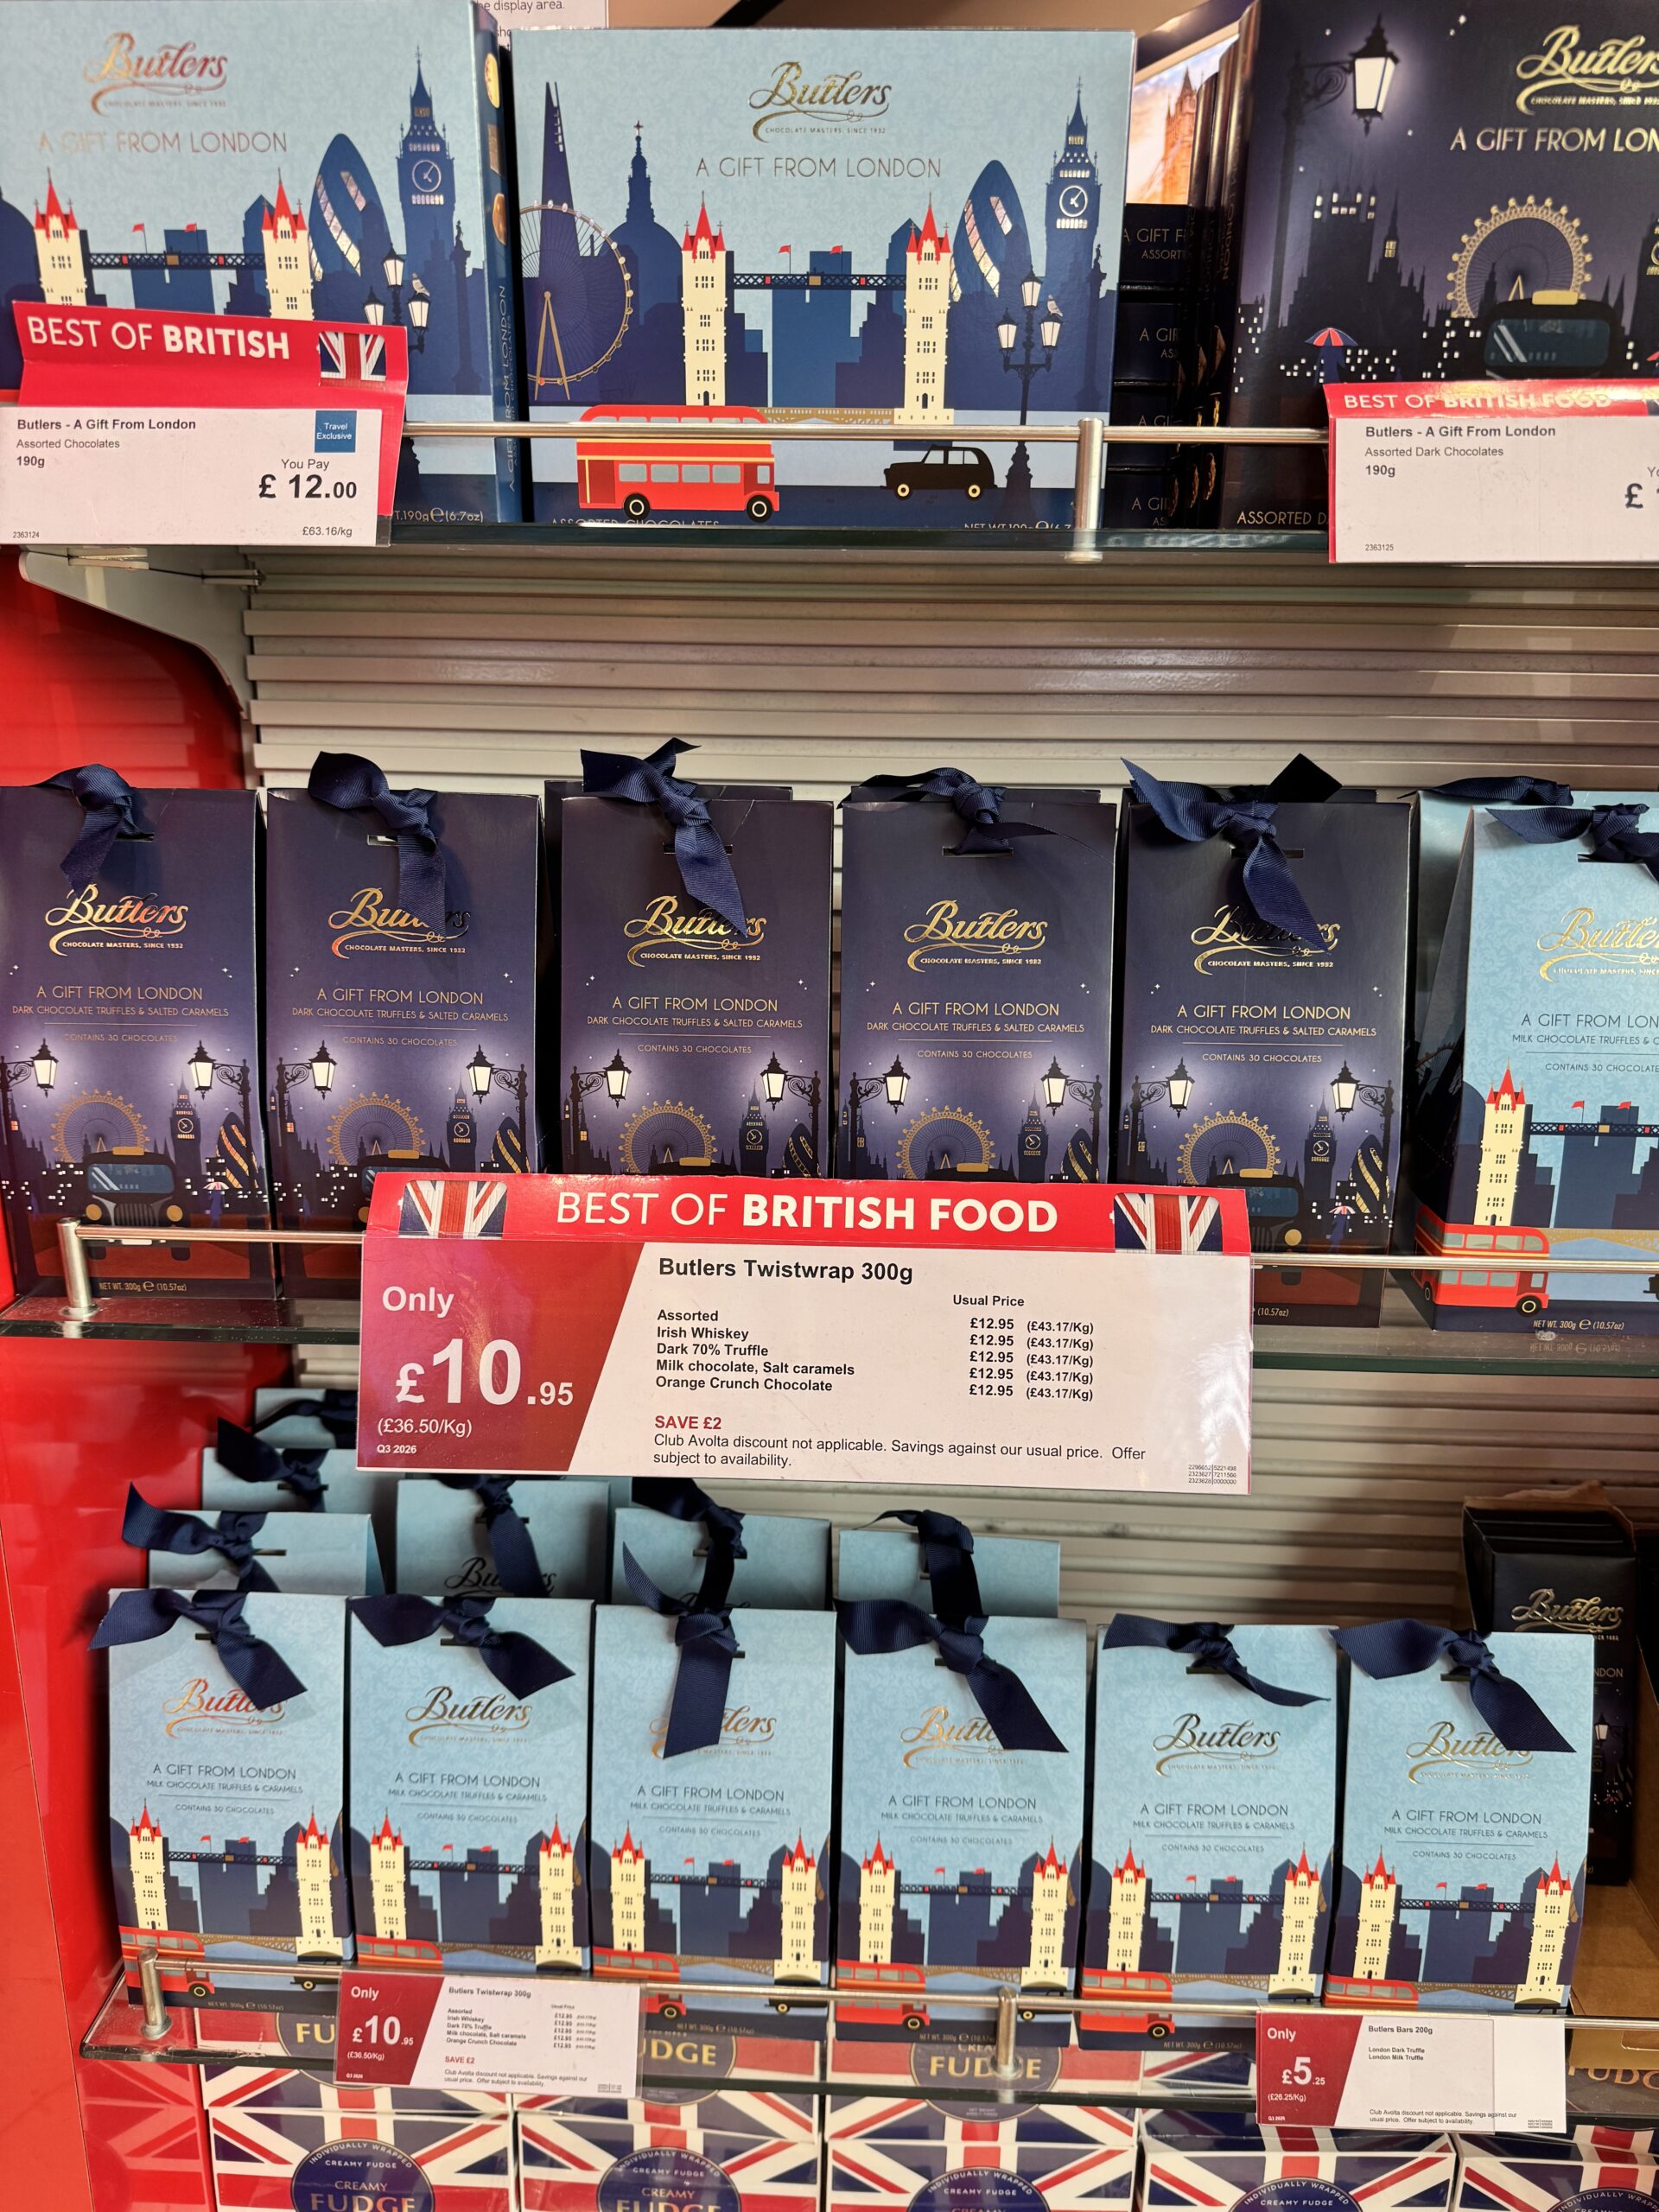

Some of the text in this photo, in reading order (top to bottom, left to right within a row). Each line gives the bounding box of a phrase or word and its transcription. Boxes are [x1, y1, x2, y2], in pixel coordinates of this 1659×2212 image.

[494, 0, 564, 13] display area.
[84, 32, 227, 91] Butlers
[748, 61, 892, 117] Butlers
[39, 131, 287, 153] A GIFT FROM LONDON
[1450, 128, 1606, 151] A GIFT FROM
[696, 156, 940, 177] A GIFT FROM LONDON
[27, 316, 289, 359] BEST OF BRITISH
[1344, 394, 1611, 409] BEST OF BRITISH FOOD
[17, 418, 195, 429] Butlers A Gift From London
[315, 431, 352, 442] Exclusive
[1365, 425, 1555, 437] Butlers A Gift From London
[16, 439, 119, 448] Assorted Chocolates
[1364, 447, 1503, 456] Assorted Dark Chocolates
[16, 455, 44, 468] 190g
[281, 458, 329, 471] You Pay
[1365, 464, 1395, 478] 190g
[258, 474, 356, 499] £ 12.00
[1236, 511, 1311, 524] ASSORTED
[302, 526, 352, 537] £63.16/kg
[905, 900, 1046, 950] Butlers
[892, 1001, 1058, 1015] A GIFT FROM LONDON
[867, 1021, 1084, 1033] DARK CHOCOLATE TRUFFLES & SALTED CARAMELS
[556, 1191, 1057, 1231] BEST OF BRITISH FOOD
[659, 1257, 912, 1285] Butlers Twistwrap 300g
[382, 1286, 454, 1318] Only
[953, 1294, 1024, 1306] Usual Price
[657, 1309, 718, 1321] Assorted
[969, 1317, 1014, 1329] £12.95
[1027, 1320, 1093, 1334] (£43.17/Kg)
[657, 1326, 748, 1341] Irish Whiskey
[969, 1334, 1014, 1346] £12.95
[657, 1342, 768, 1356] Dark 70% Truffle
[1027, 1338, 1093, 1351] (£43.17/Kg)
[969, 1351, 1013, 1363] £12.95
[1027, 1354, 1093, 1368] (£43.17/Kg)
[396, 1338, 574, 1406] £10.95
[656, 1359, 854, 1375] Milk chocolate, Salt caramels
[969, 1367, 1013, 1379] £12.95
[656, 1376, 832, 1390] Orange Crunch Chocolate
[1026, 1370, 1093, 1384] (£43.17/Kg)
[969, 1383, 1013, 1396] £12.95
[1026, 1387, 1092, 1402] (£43.17/Kg)
[378, 1418, 472, 1437] (£36.50/Kg)
[654, 1415, 721, 1429] SAVE £2
[376, 1444, 416, 1453] Q3 2026
[654, 1433, 1146, 1459] Club Avolta discount not applicable. Savings against our usual price. Offer
[653, 1452, 791, 1468] subject to availability.
[1153, 1713, 1281, 1758] Butlers
[1140, 1802, 1287, 1815] A GIFT FROM LONDON
[1154, 1821, 1204, 1829] CHOCOLATE
[351, 1986, 378, 2001] Only
[353, 2015, 413, 2045] £10.95
[1267, 2027, 1296, 2042] Only
[1414, 2026, 1433, 2035] 200g
[1282, 2056, 1325, 2085] £5.25
[309, 2143, 412, 2169] INDIVIDUALLY WRAPPED
[334, 2180, 387, 2191] CREAMY
[311, 2193, 415, 2212] FUDGE
